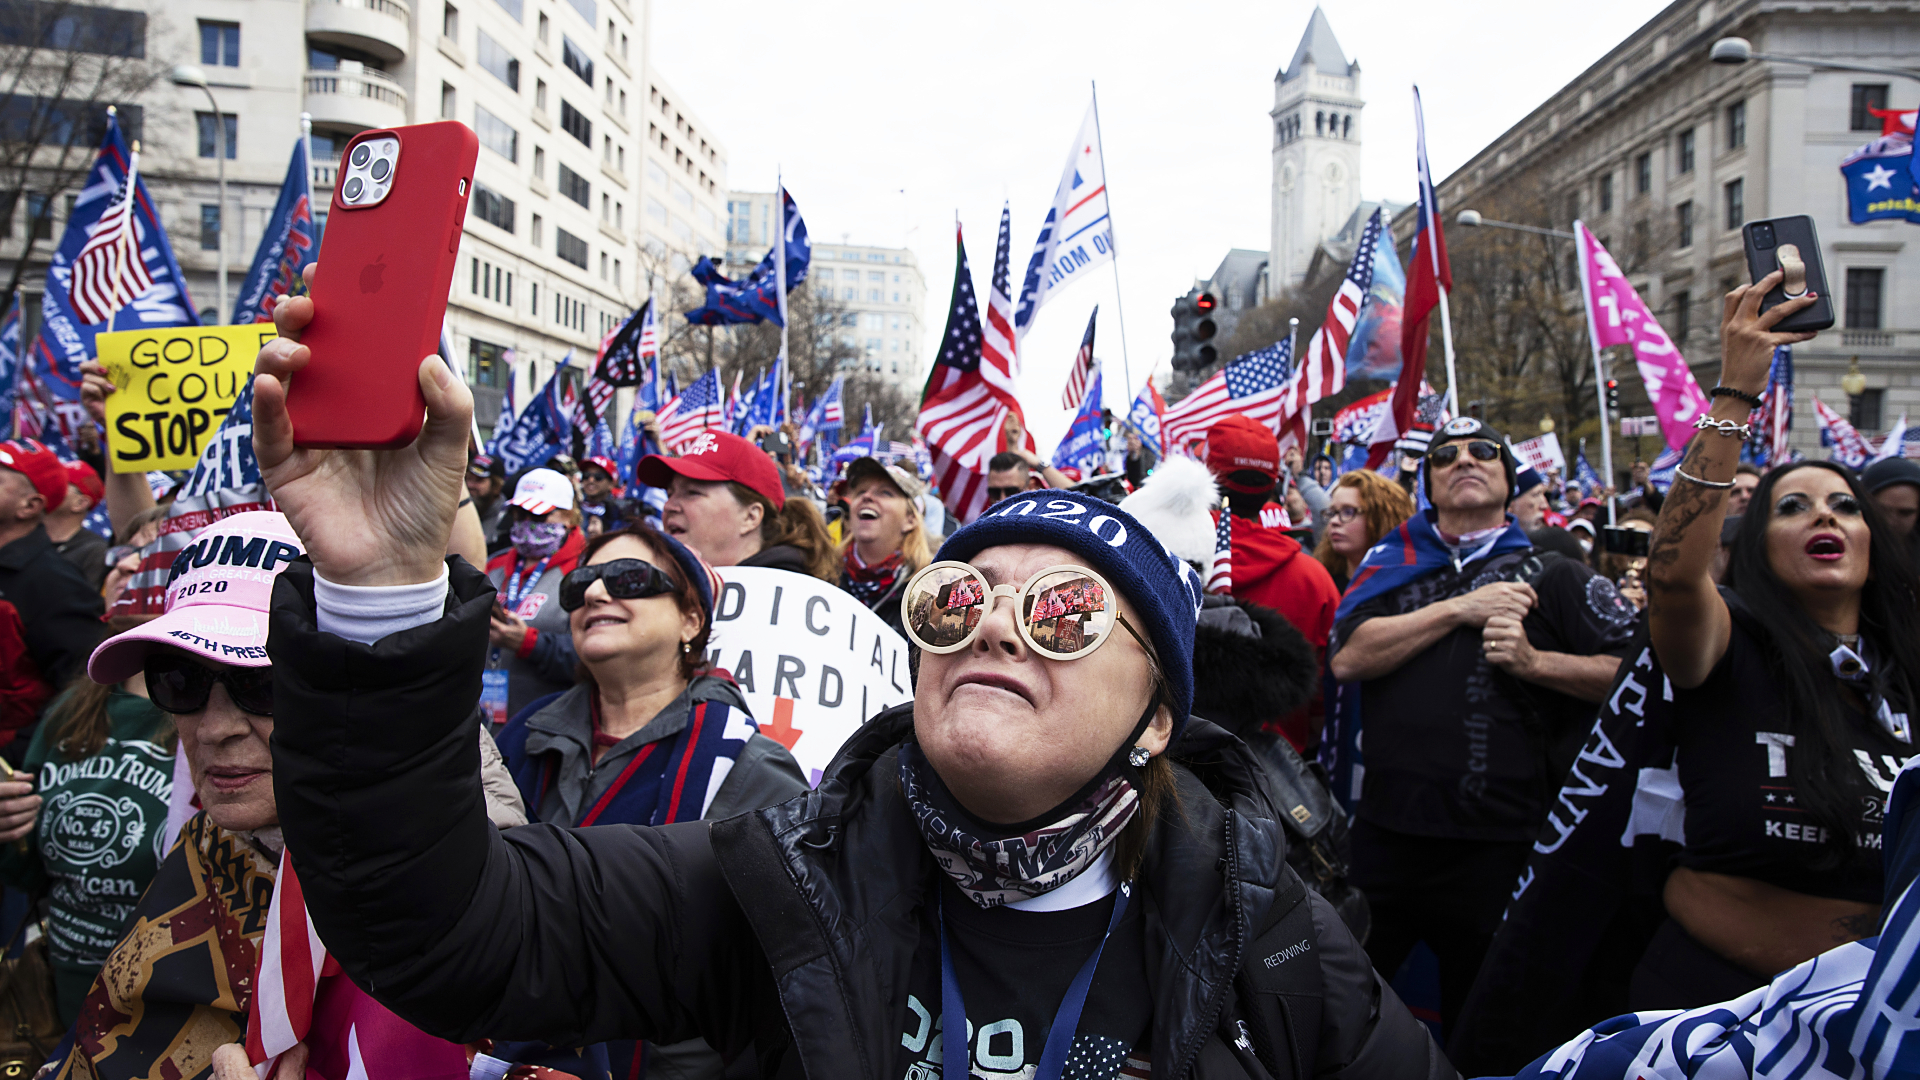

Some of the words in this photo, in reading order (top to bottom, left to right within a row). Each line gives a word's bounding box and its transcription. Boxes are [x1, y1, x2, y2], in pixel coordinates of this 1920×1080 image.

[130, 336, 229, 368] GOD
[147, 371, 254, 405] COU
[177, 580, 228, 600] 2020
[221, 645, 268, 659] PRES
[715, 581, 904, 695] DICIAL
[112, 754, 175, 807] TRUM
[57, 815, 87, 836] No.
[90, 819, 114, 839] 45
[973, 891, 1006, 909] And
[1263, 939, 1311, 970] REDWING
